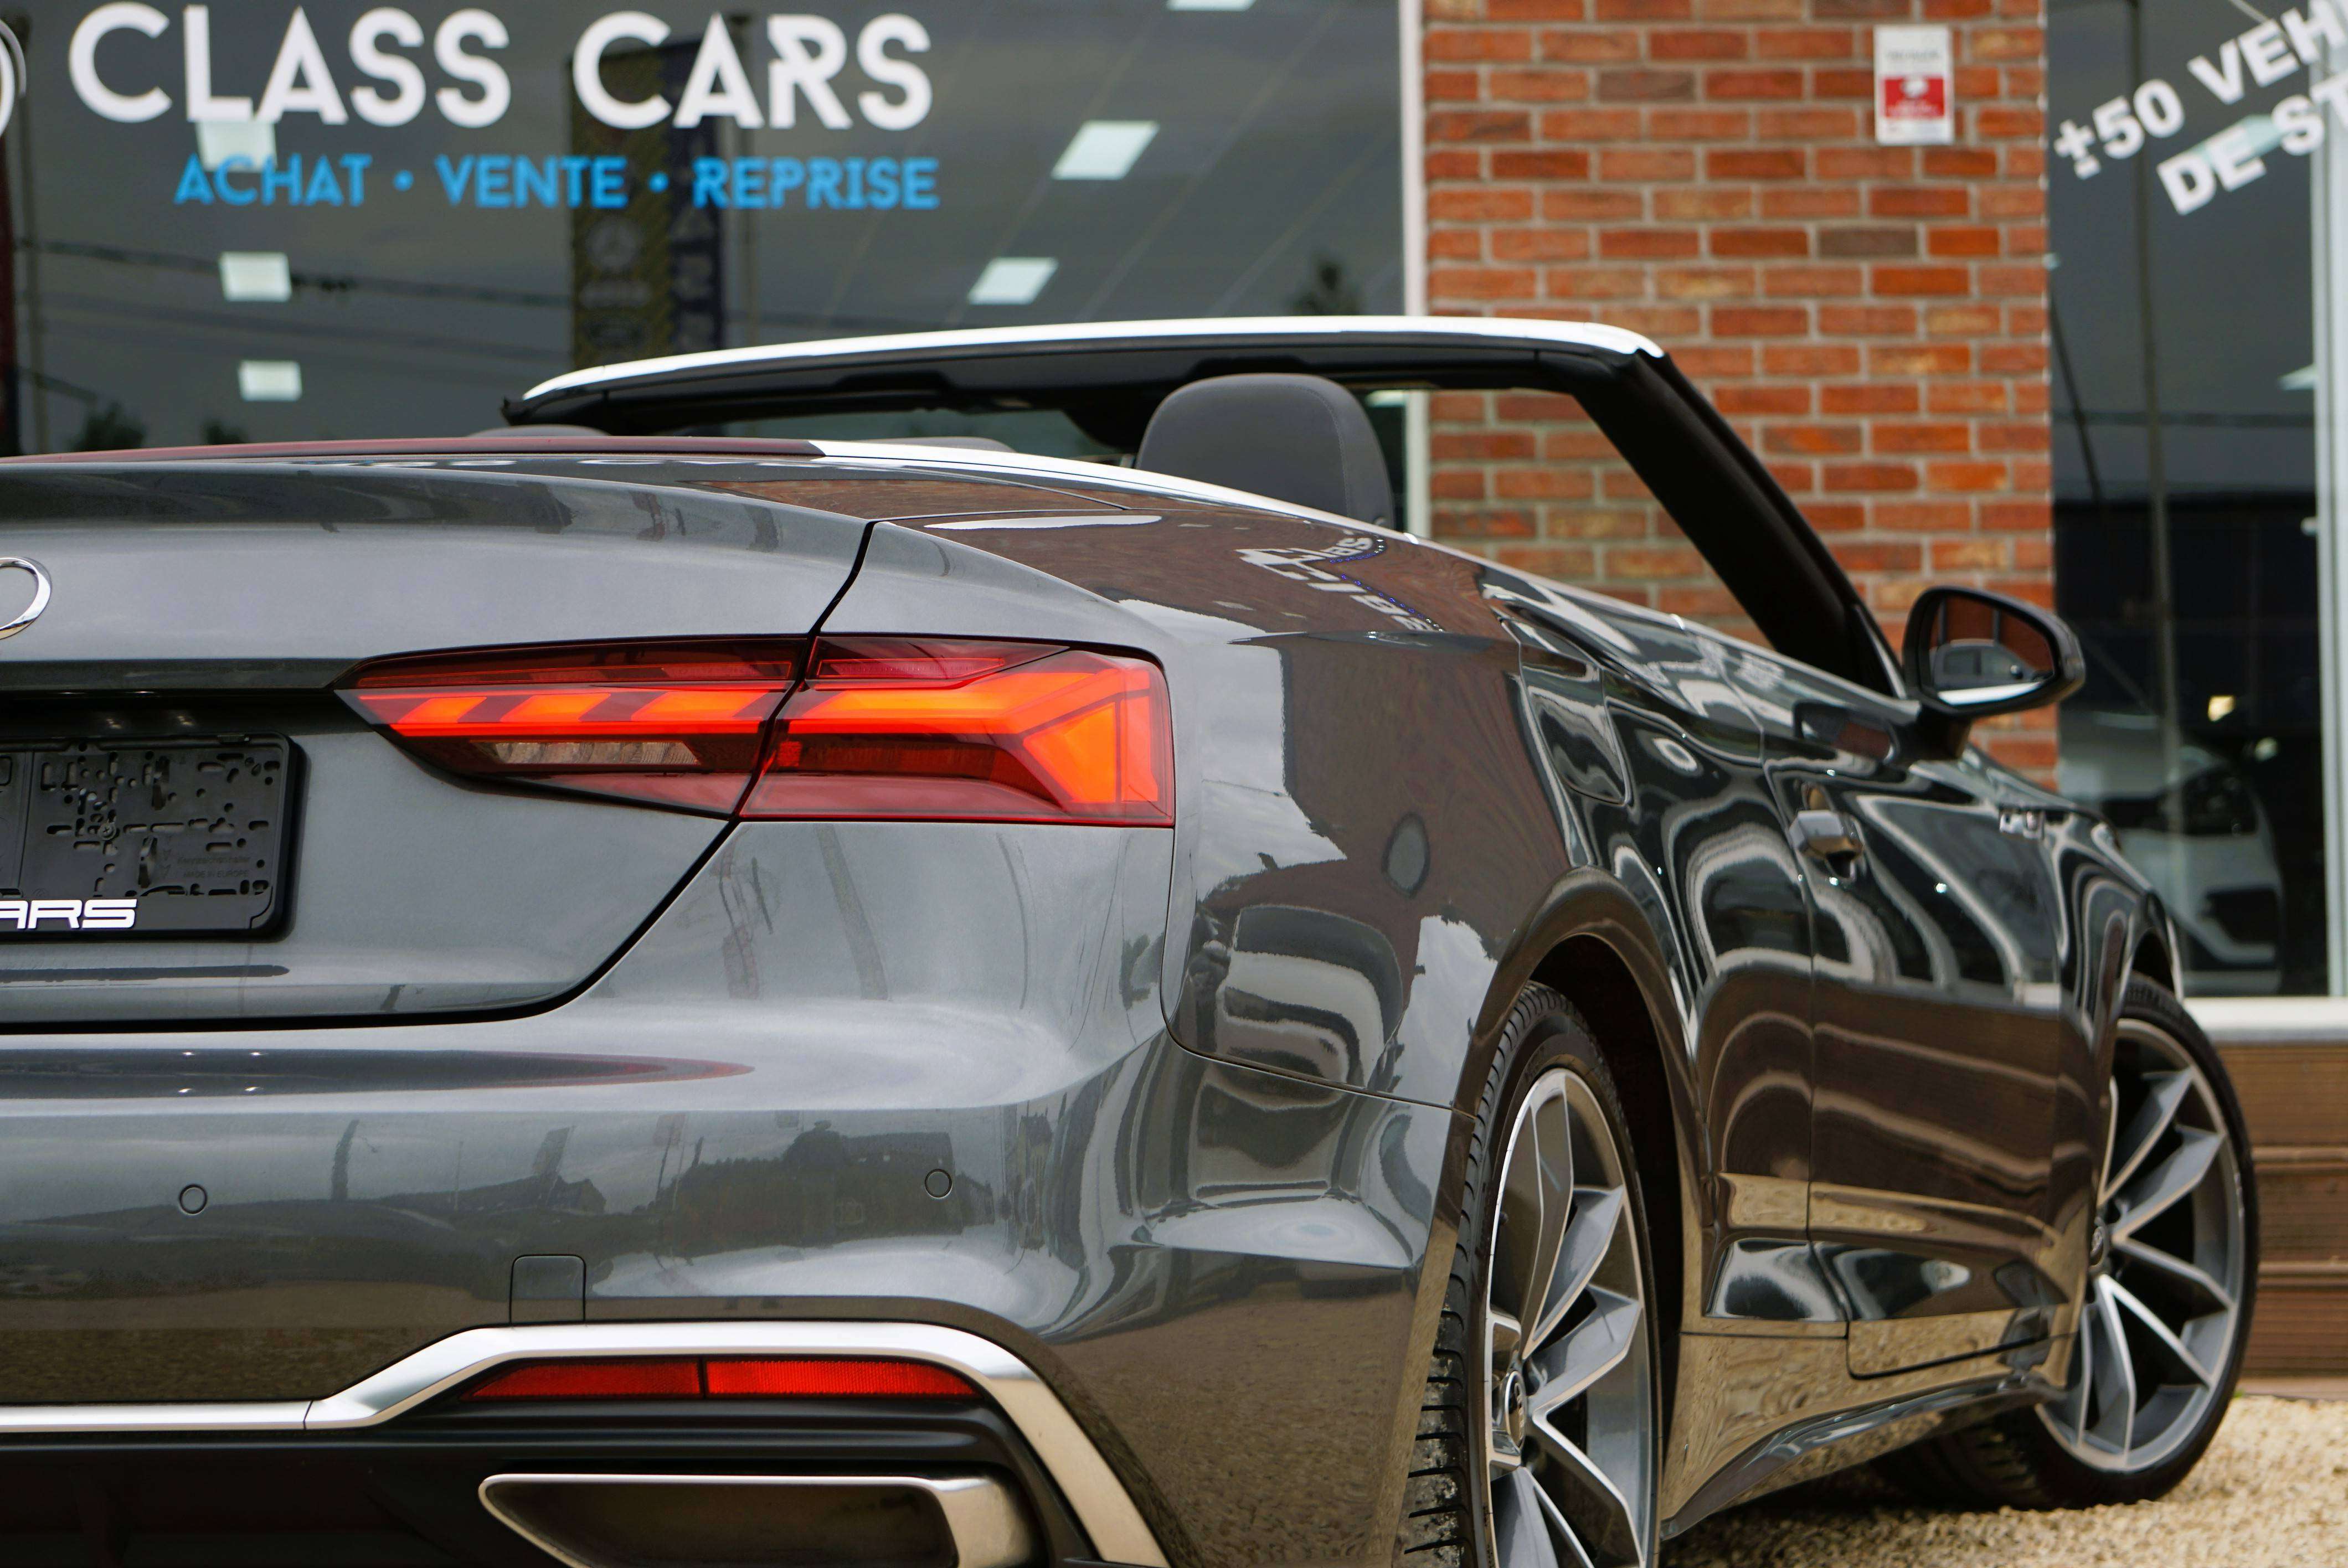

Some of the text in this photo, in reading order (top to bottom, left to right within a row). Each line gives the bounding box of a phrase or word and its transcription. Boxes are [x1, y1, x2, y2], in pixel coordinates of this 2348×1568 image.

[69, 2, 933, 130] CLASS CARS
[2187, 0, 2348, 105] VEH
[173, 153, 940, 210] ACHAT VENTE REPRISE
[2156, 125, 2267, 216] DE
